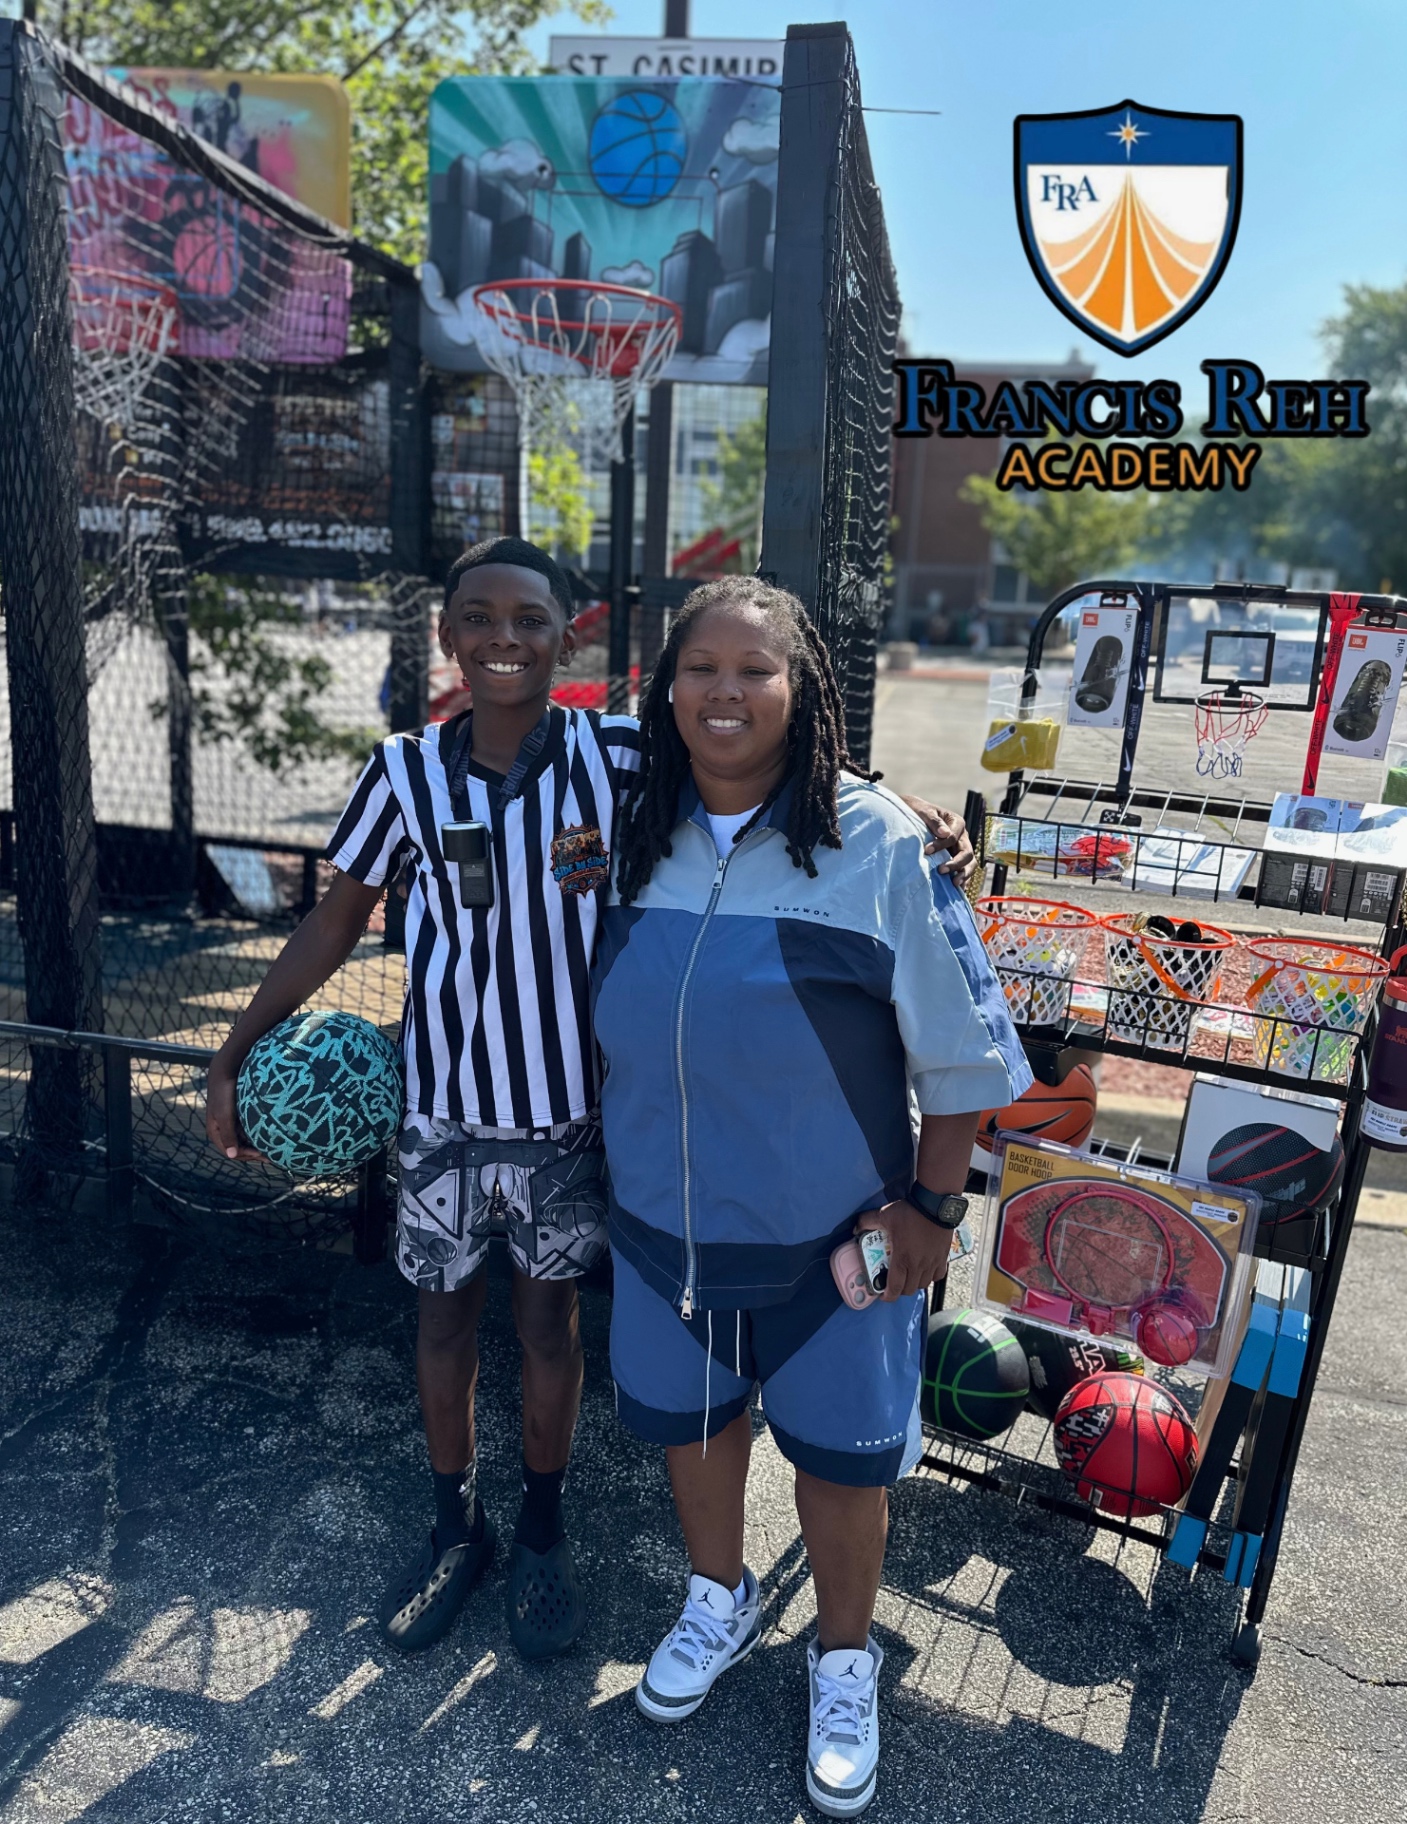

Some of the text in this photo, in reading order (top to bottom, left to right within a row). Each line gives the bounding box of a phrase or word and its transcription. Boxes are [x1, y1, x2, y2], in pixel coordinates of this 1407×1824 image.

[774, 905, 830, 917] SUMWON
[1010, 1151, 1054, 1171] BASKETBALL
[1008, 1162, 1052, 1180] DOOR HOOP
[856, 1431, 902, 1446] SUMWON
